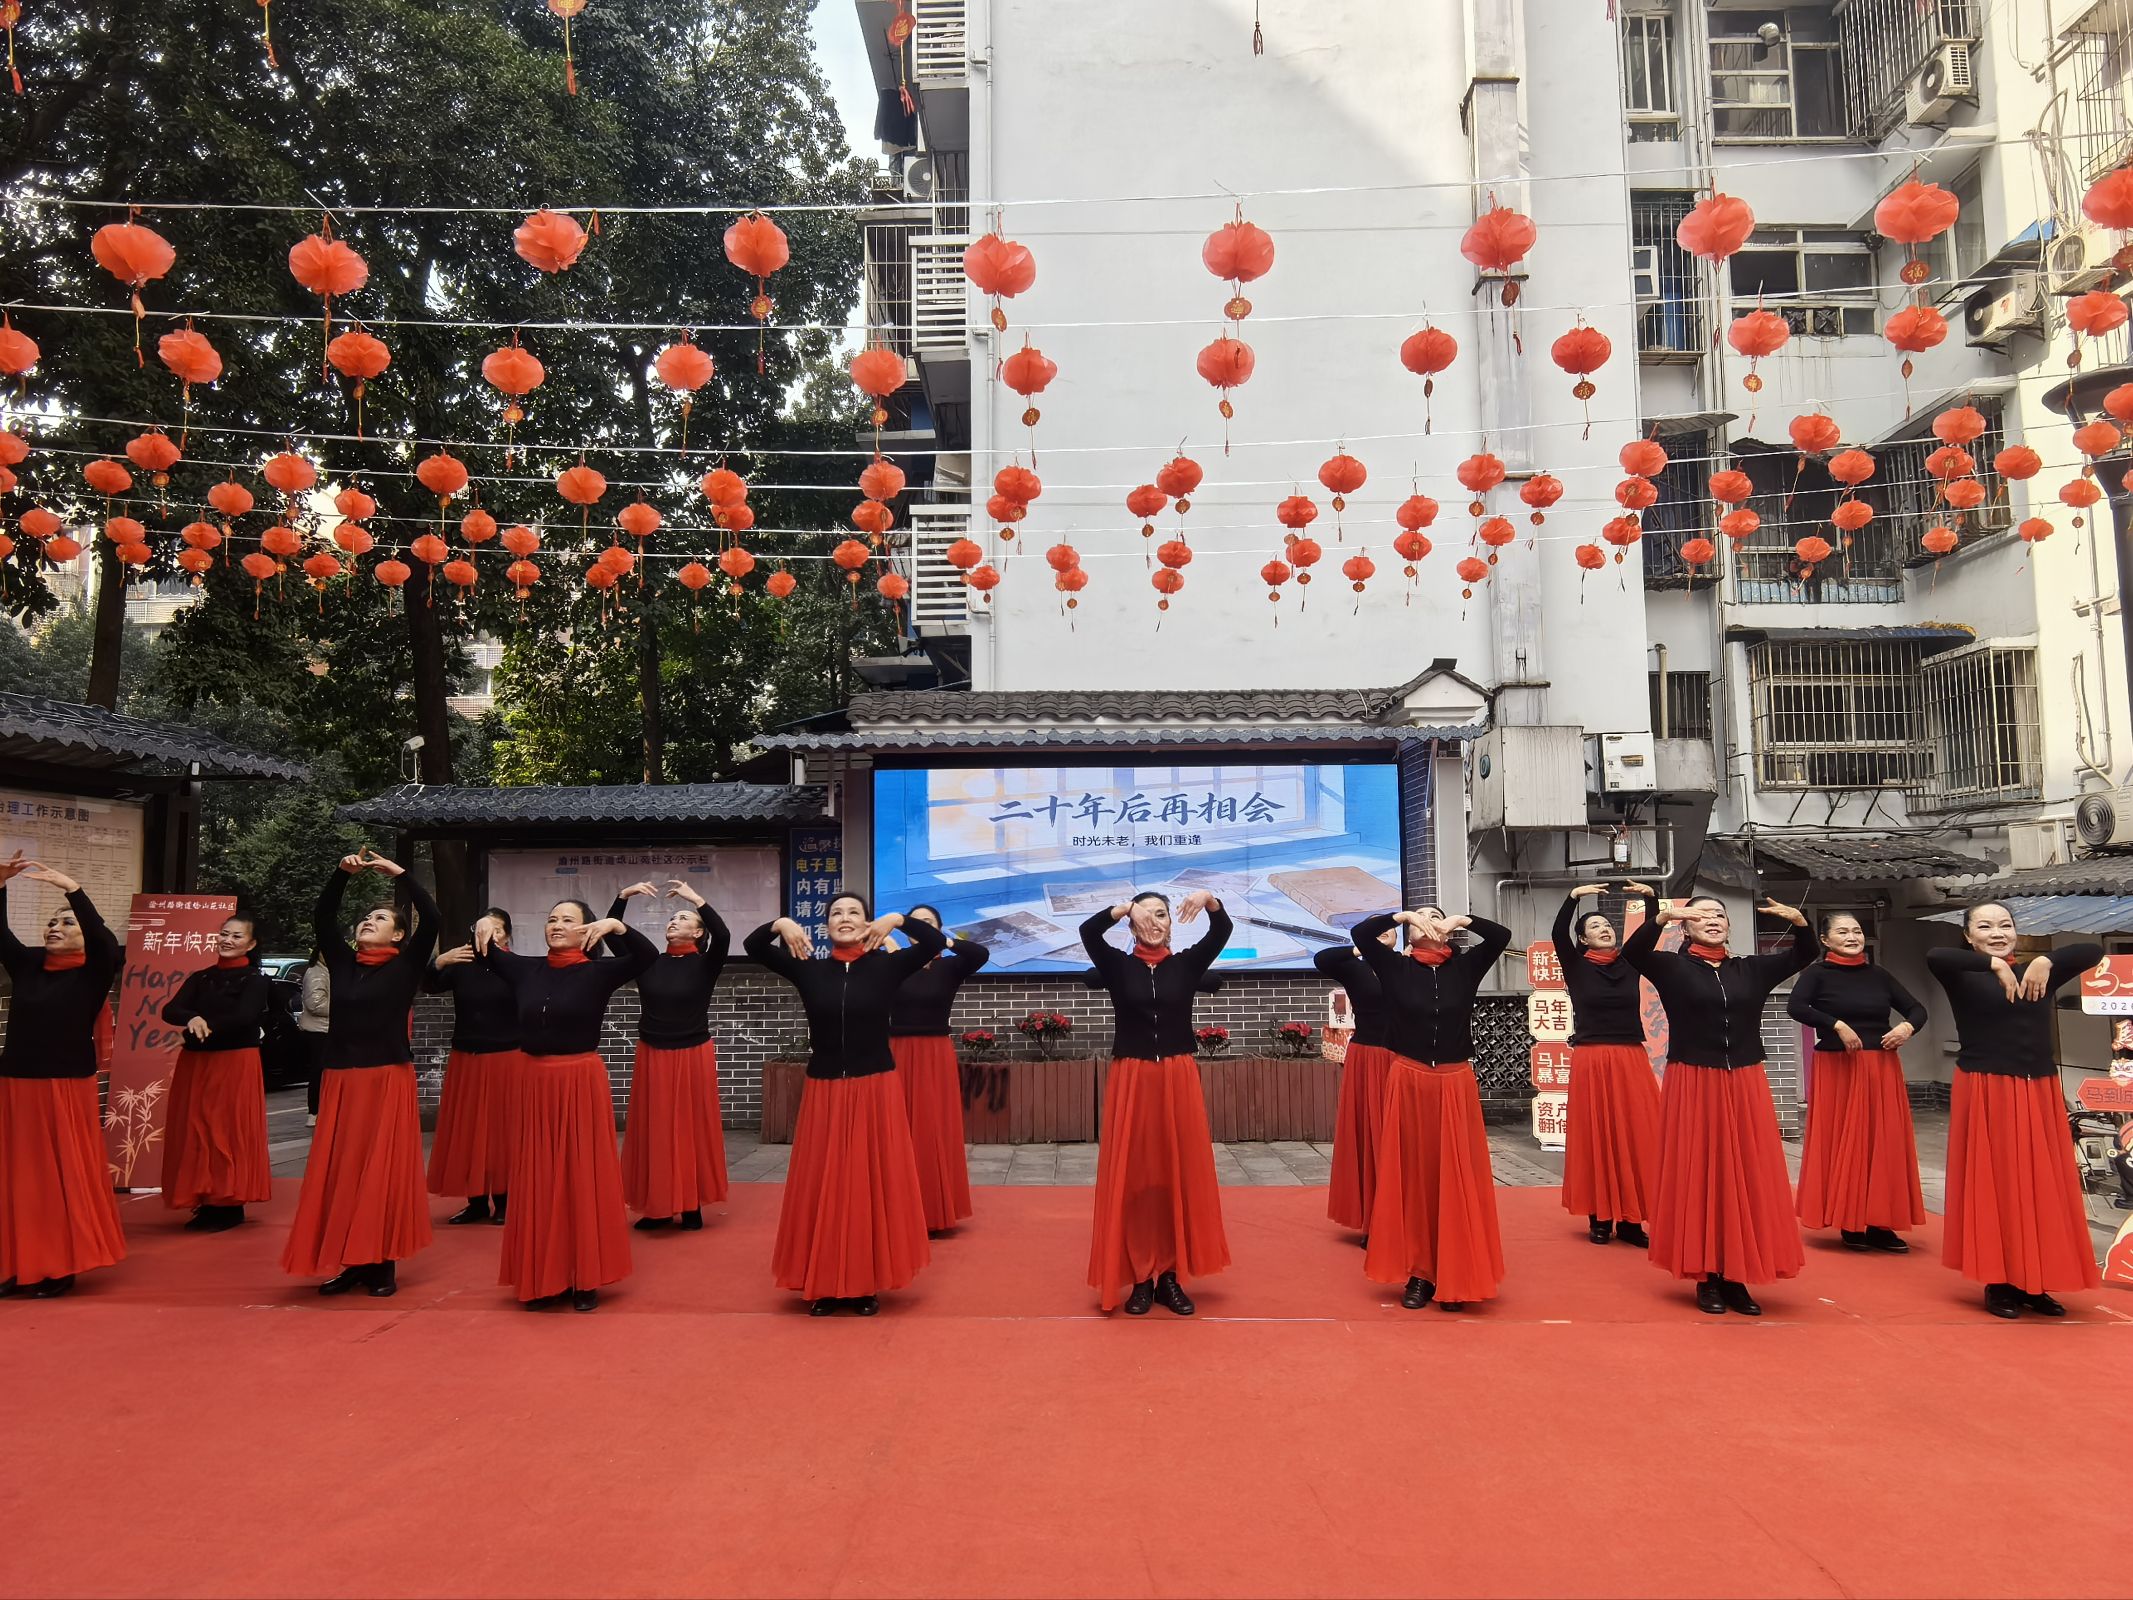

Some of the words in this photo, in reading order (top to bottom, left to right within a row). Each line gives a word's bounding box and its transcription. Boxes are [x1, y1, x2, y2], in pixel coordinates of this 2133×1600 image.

[989, 792, 1286, 830] 二十年后再相会
[796, 857, 842, 873] 电子显
[142, 930, 220, 956] 新年快乐
[1532, 966, 1565, 982] 快乐
[1534, 999, 1568, 1015] 马年
[1533, 1014, 1568, 1031] 大吉
[1536, 1052, 1571, 1068] 马上
[1537, 1067, 1570, 1084] 暴富
